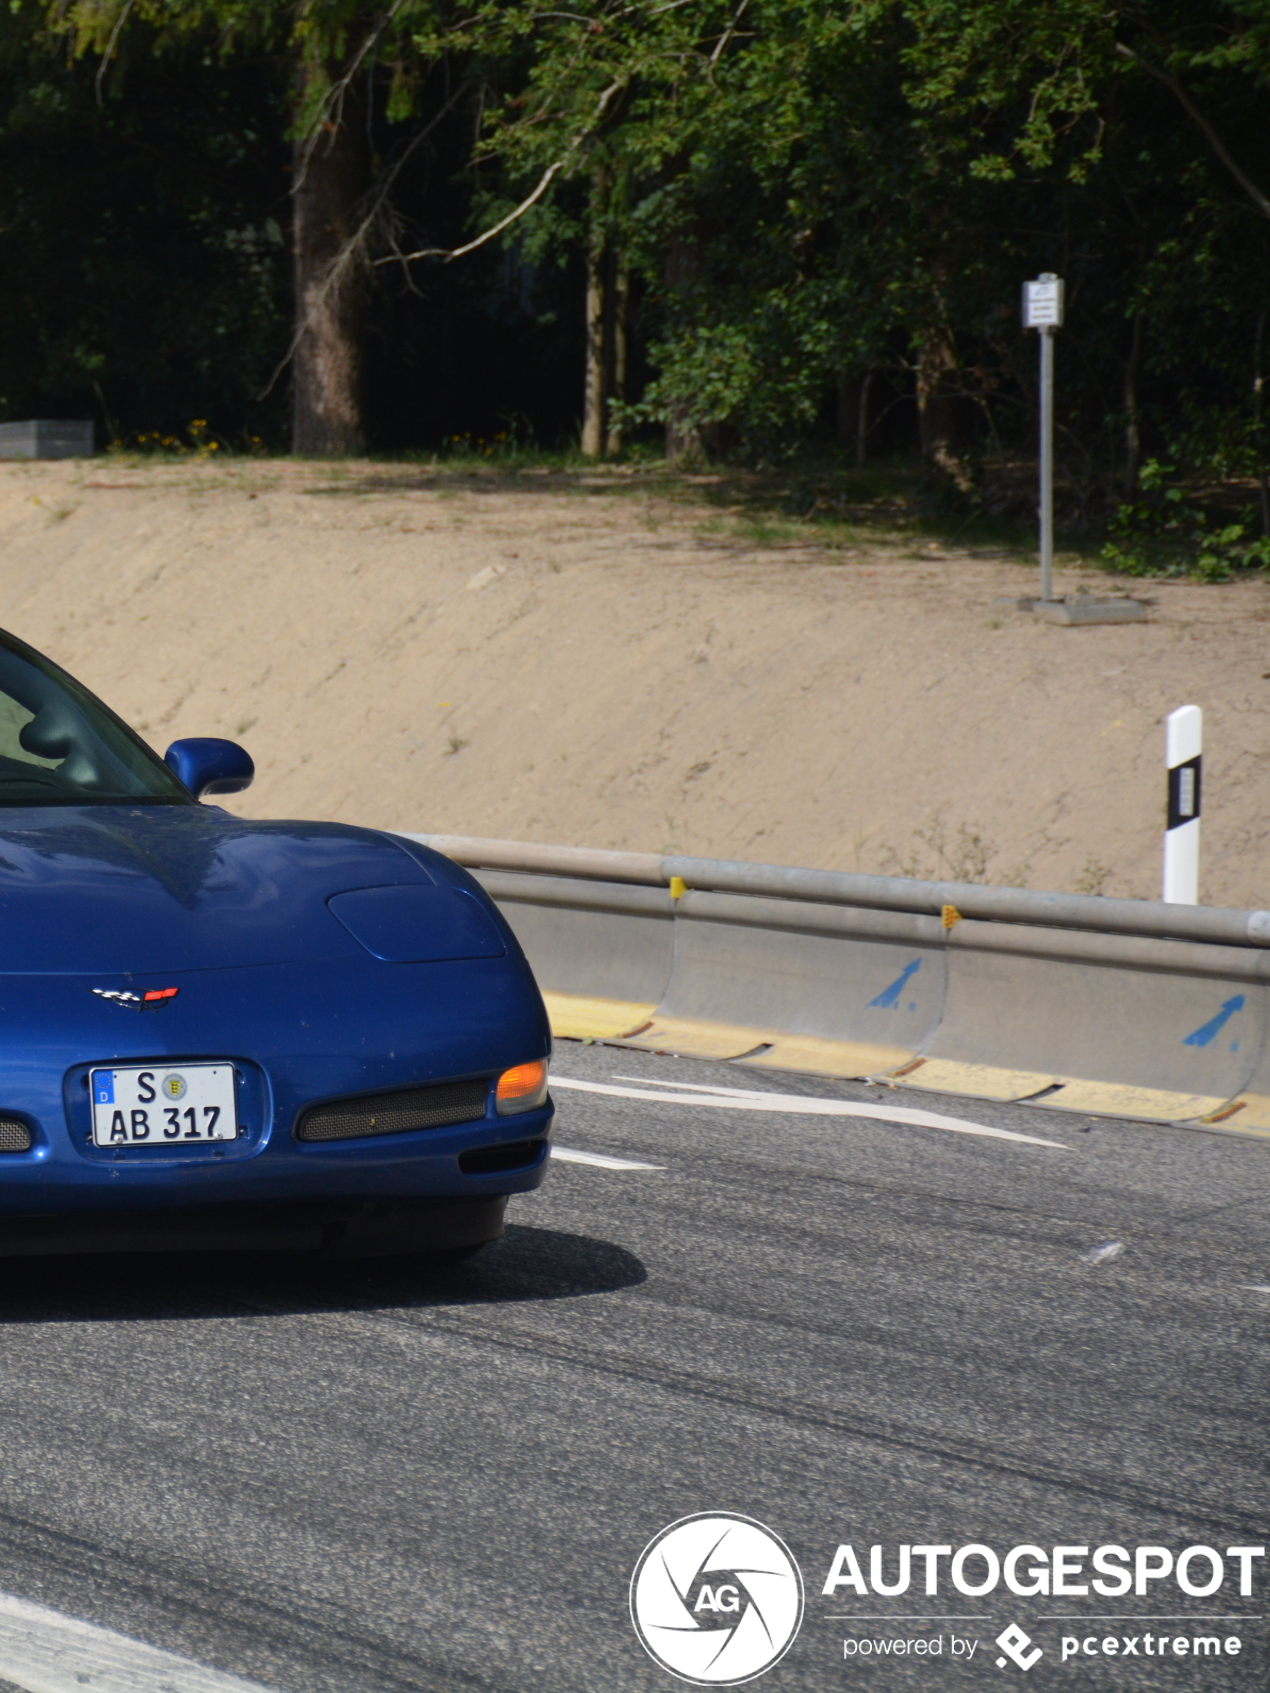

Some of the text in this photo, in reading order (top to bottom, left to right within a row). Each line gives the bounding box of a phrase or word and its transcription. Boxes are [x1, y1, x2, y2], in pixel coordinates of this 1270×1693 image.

[100, 1092, 109, 1102] D
[137, 1072, 156, 1103] S
[110, 1106, 220, 1141] AB 317
